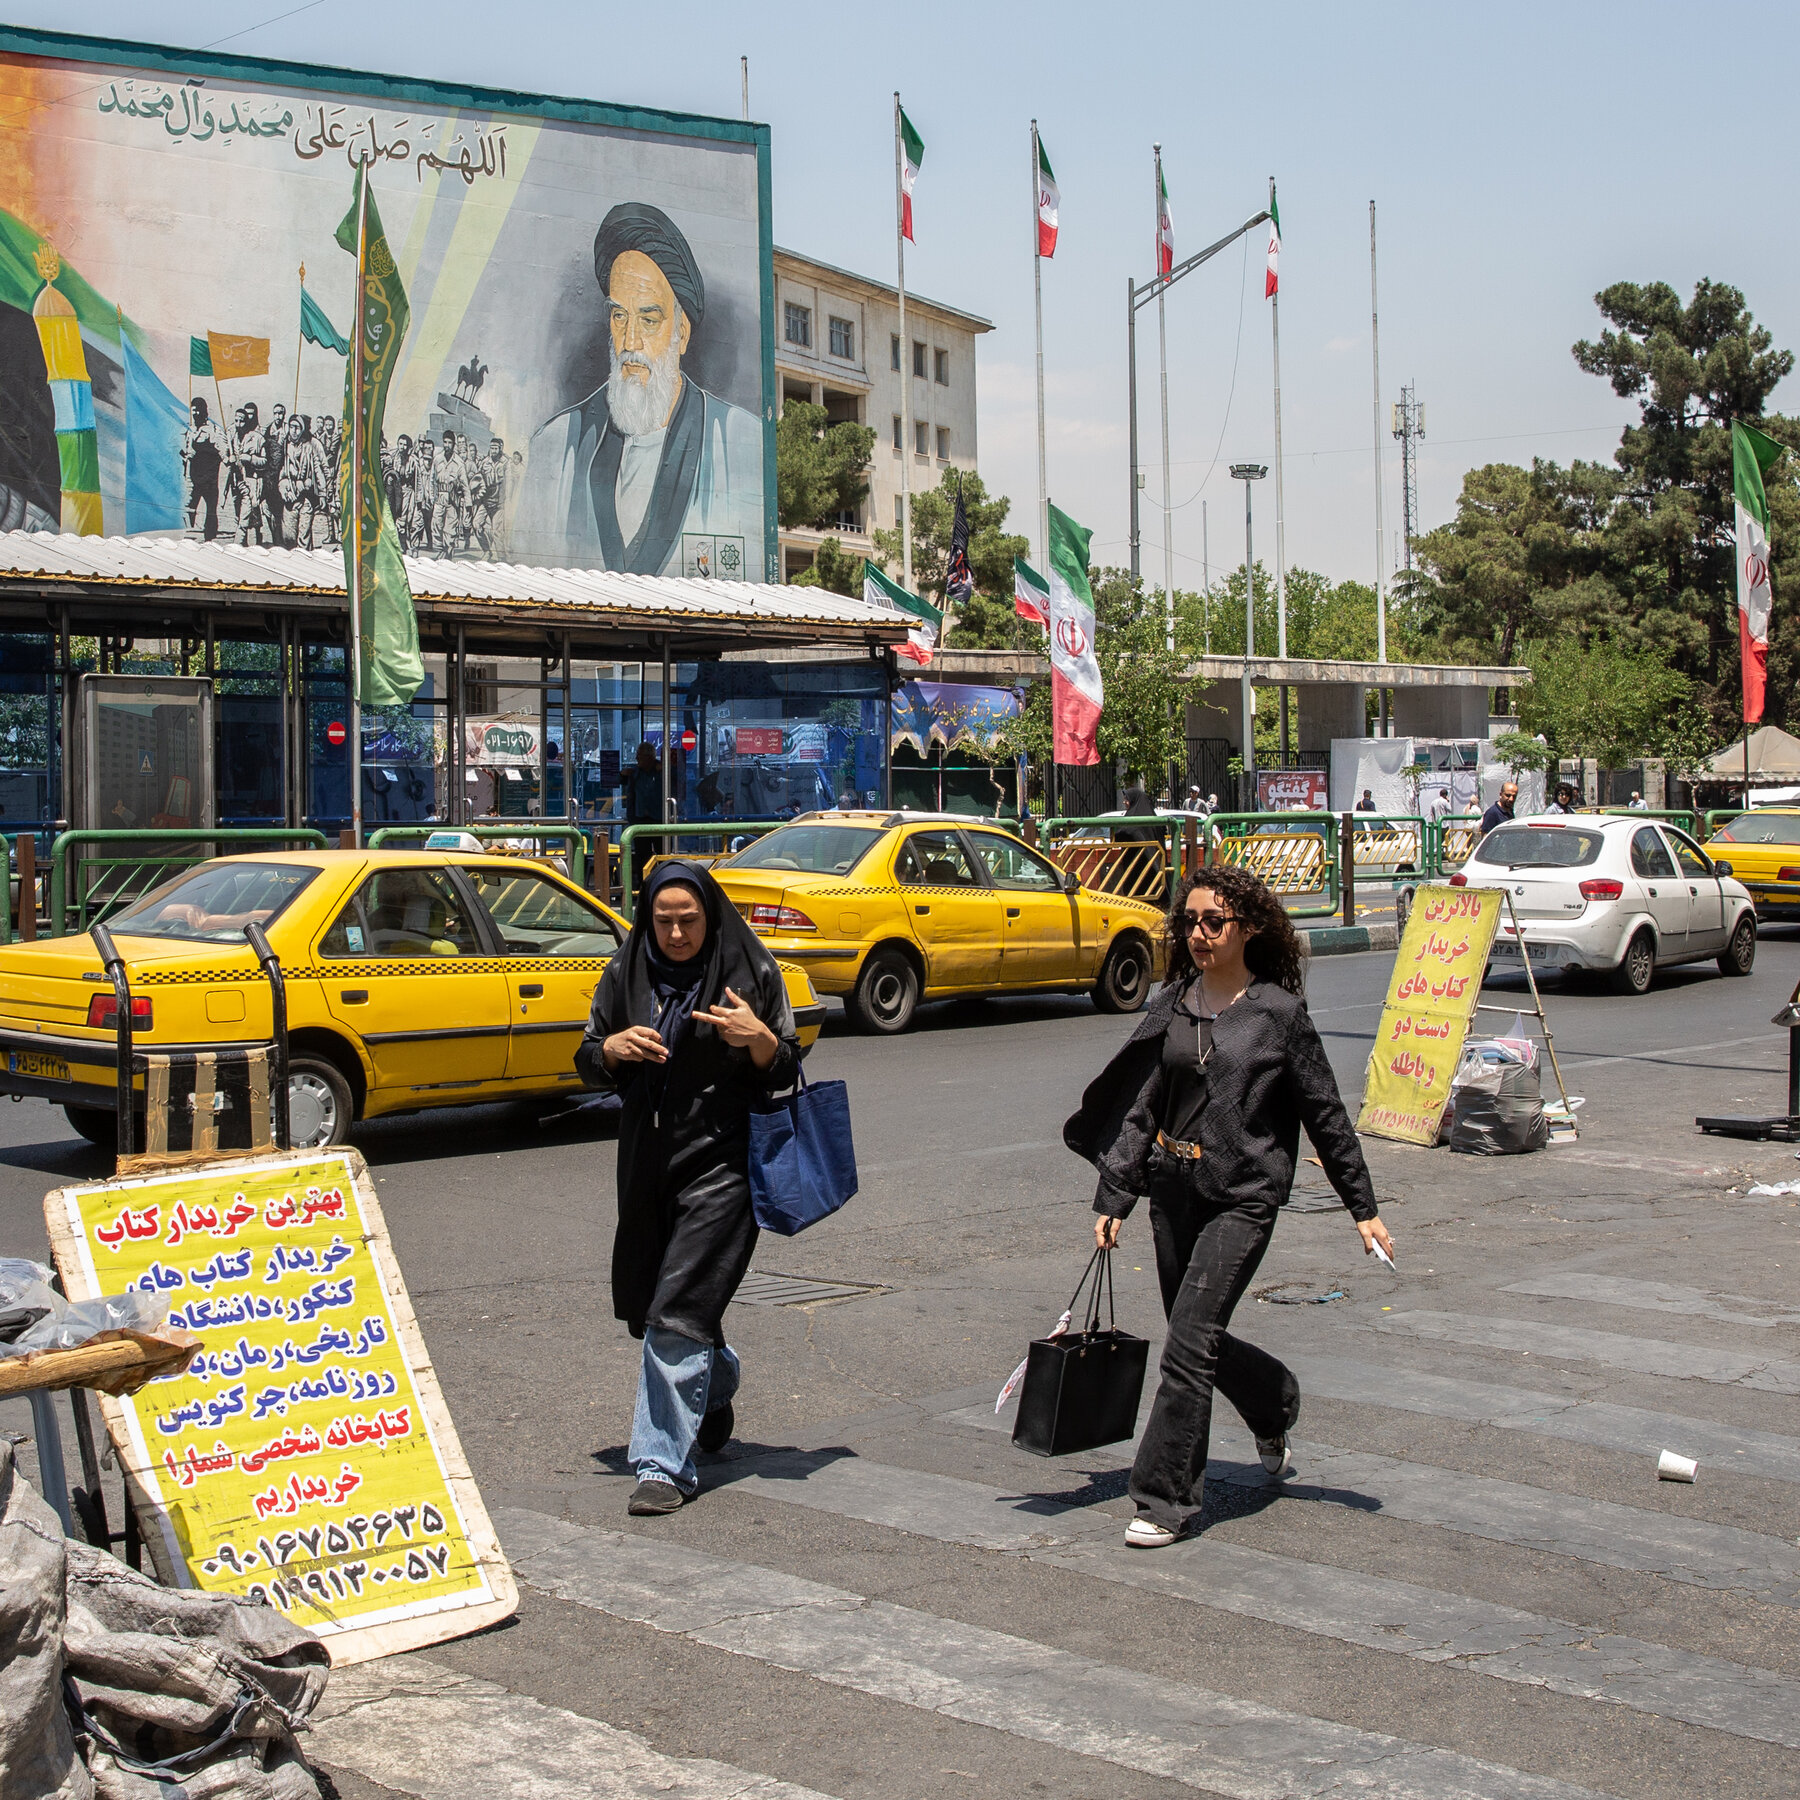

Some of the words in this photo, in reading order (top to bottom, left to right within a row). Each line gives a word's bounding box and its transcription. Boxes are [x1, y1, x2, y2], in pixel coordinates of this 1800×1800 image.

[1268, 780, 1310, 805] گفتگو
[1425, 893, 1481, 923] بالاترین
[1415, 932, 1470, 963] خریدار
[1397, 971, 1428, 999] های
[1431, 975, 1470, 1002] کتاب
[1391, 1016, 1411, 1040] دو
[1415, 1018, 1450, 1038] دست
[1390, 1052, 1425, 1084] باطله
[1424, 1066, 1435, 1087] و
[165, 1195, 255, 1244] خریدار
[266, 1189, 345, 1227] بهترین
[97, 1206, 158, 1250] کتاب
[191, 1251, 251, 1289] کتاب
[266, 1237, 351, 1281] خریدار
[128, 1264, 183, 1293] های
[327, 1408, 409, 1447] کتابخانه
[241, 1426, 321, 1472] شخصی
[255, 1463, 361, 1517] خریداریم
[203, 1504, 444, 1573] ۰۹۰۱۶۷۵۴۶۳۵
[250, 1546, 448, 1609] ۹۱۹۹۱۳۰۰۵۷
